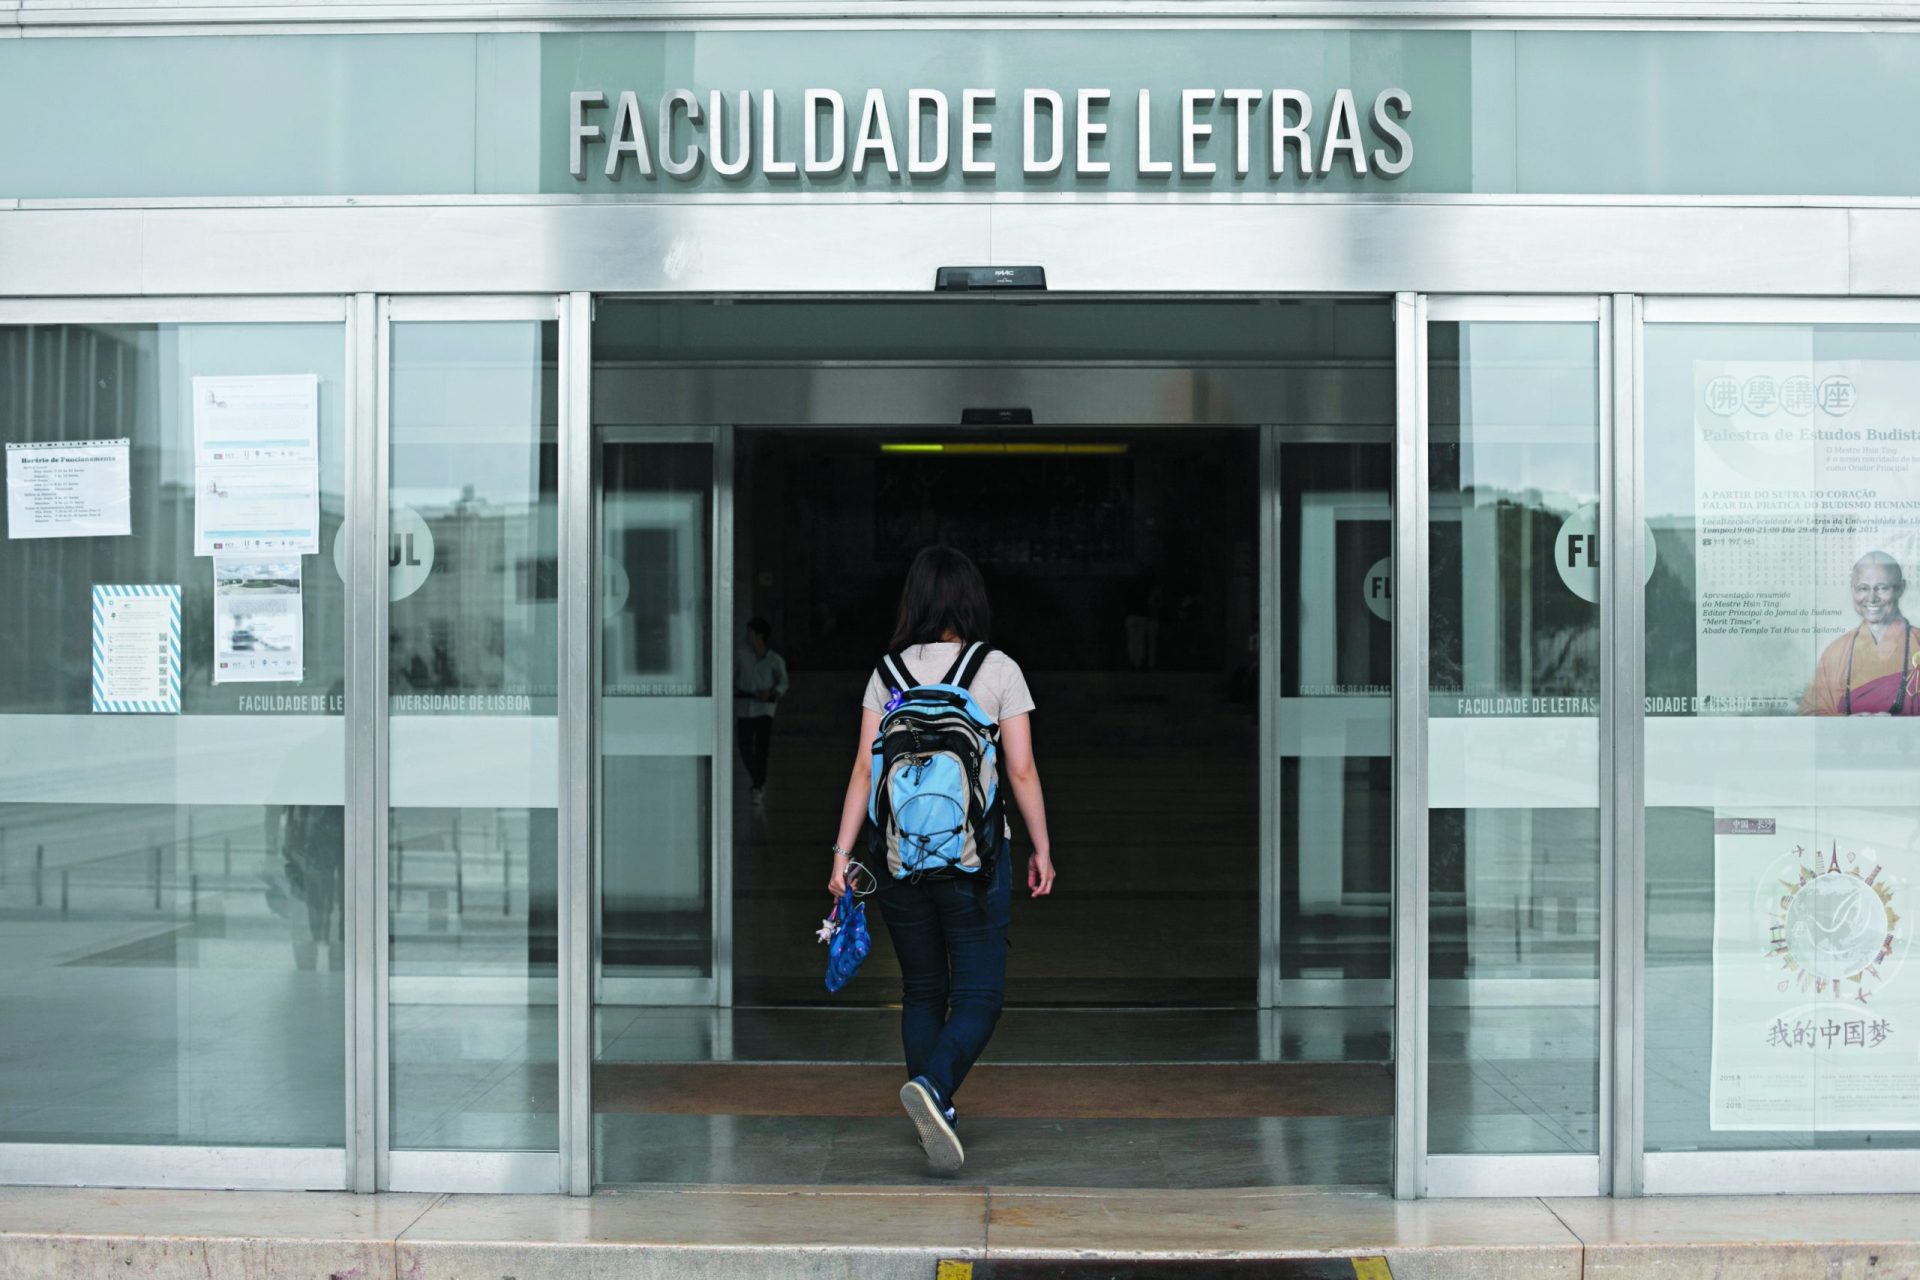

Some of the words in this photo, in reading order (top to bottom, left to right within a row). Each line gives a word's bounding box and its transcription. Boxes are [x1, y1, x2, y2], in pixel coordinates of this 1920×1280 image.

[568, 88, 998, 178] FACULDADE
[1022, 87, 1112, 176] DE
[1136, 87, 1415, 177] LETRAS
[1709, 379, 1852, 411] 佛學講座
[1702, 427, 1770, 442] Palestra
[1774, 427, 1794, 441] de
[1799, 427, 1862, 442] Estudos
[1876, 464, 1909, 473] Principal
[1702, 490, 1709, 499] A
[1711, 490, 1752, 499] PARTIR
[1753, 490, 1770, 499] DO
[1771, 490, 1807, 499] SUTRA
[1809, 490, 1825, 499] DO
[1826, 488, 1877, 501] CORAÇÃO
[1702, 501, 1737, 509] FALAR
[1738, 501, 1754, 509] DA
[1804, 501, 1820, 509] DO
[1821, 501, 1872, 509] BUDISMO
[1820, 526, 1845, 535] Junho
[1567, 533, 1601, 568] FL
[1702, 591, 1754, 600] Apresentação
[1713, 600, 1741, 608] Mestre
[1702, 609, 1728, 617] Editor
[1728, 609, 1762, 619] Principal
[1774, 609, 1798, 618] Jornal
[1811, 609, 1843, 617] Budismo
[1702, 626, 1728, 635] Abade
[1740, 626, 1769, 636] Templo
[1299, 684, 1347, 696] FACULDADE
[1347, 684, 1360, 696] DE
[1360, 684, 1391, 696] LETRAS
[239, 695, 309, 712] FACULDADE
[310, 695, 327, 711] DE
[468, 695, 485, 711] DE
[487, 694, 531, 711] LISBOA
[1458, 697, 1529, 715] FACULDADE
[1531, 697, 1548, 713] DE
[1550, 696, 1597, 713] LETRAS
[1691, 696, 1706, 713] DE
[1709, 696, 1754, 713] LISBOA
[1765, 1017, 1895, 1050] 我的中国梦
